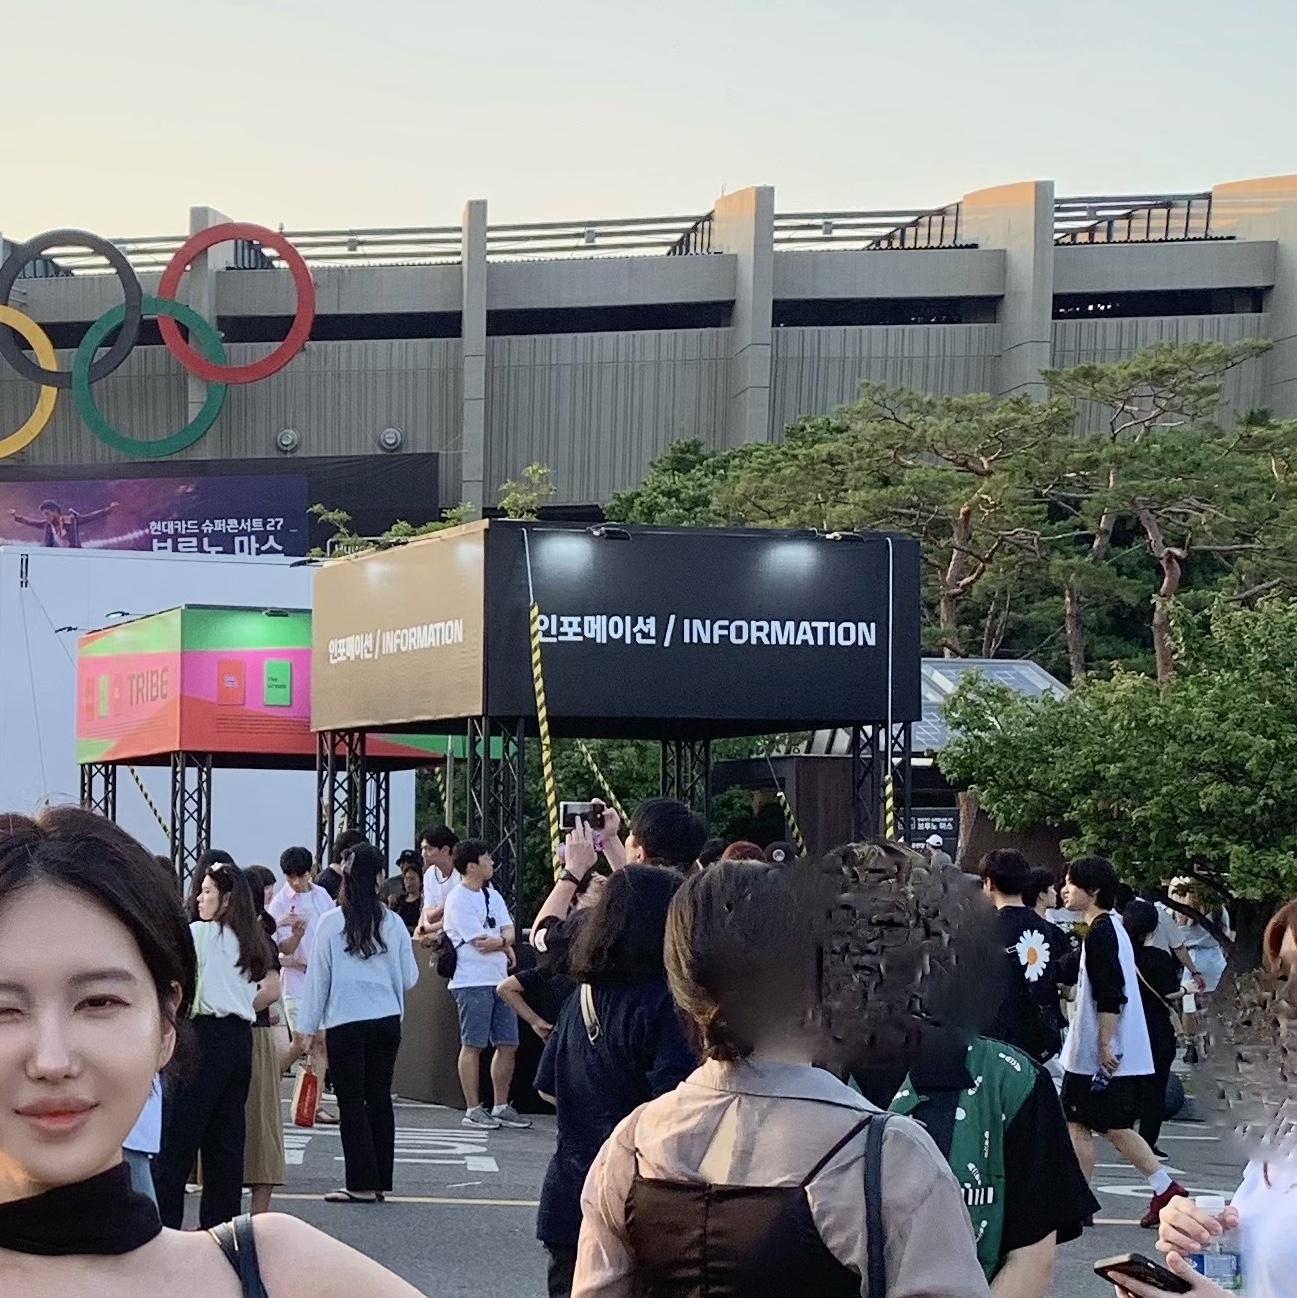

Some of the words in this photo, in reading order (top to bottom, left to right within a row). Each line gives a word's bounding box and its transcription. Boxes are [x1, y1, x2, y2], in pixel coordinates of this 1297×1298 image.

[149, 520, 199, 535] 현대카드
[201, 518, 264, 534] 슈퍼콘서트
[266, 517, 284, 531] 27
[328, 631, 373, 665] 인포메이션
[382, 618, 464, 655] INFORMATION
[537, 614, 657, 645] 인포메이션
[683, 618, 877, 647] INFORMATION
[127, 666, 169, 706] TRIBE
